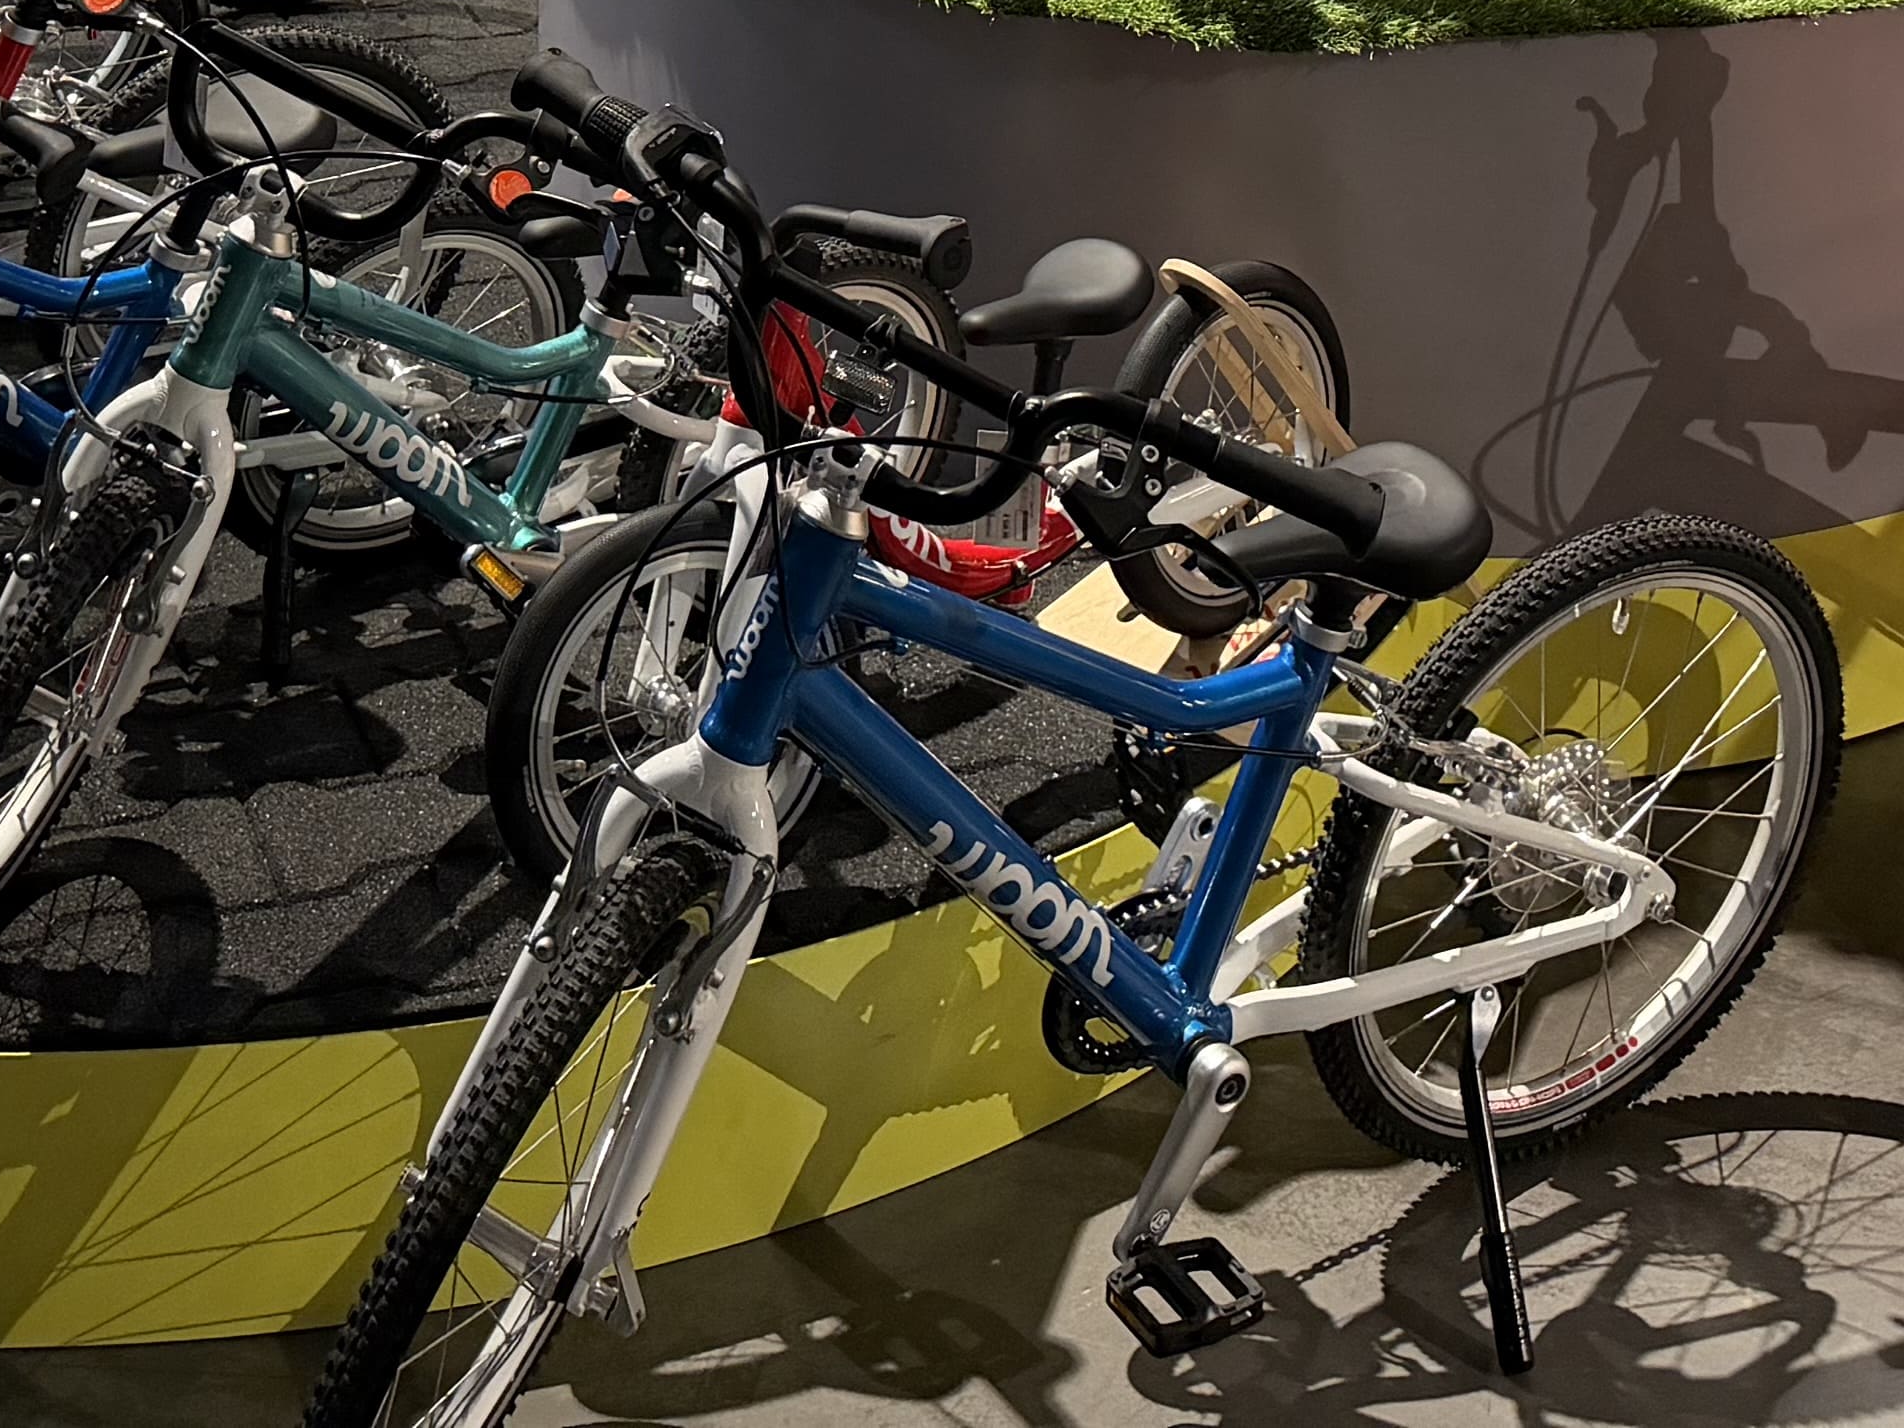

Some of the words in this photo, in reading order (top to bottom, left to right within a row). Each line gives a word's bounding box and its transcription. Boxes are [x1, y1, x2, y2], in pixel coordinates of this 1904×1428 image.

[183, 264, 232, 345] woom
[326, 400, 473, 509] woom
[725, 572, 783, 681] woom
[924, 820, 1116, 985] woom
